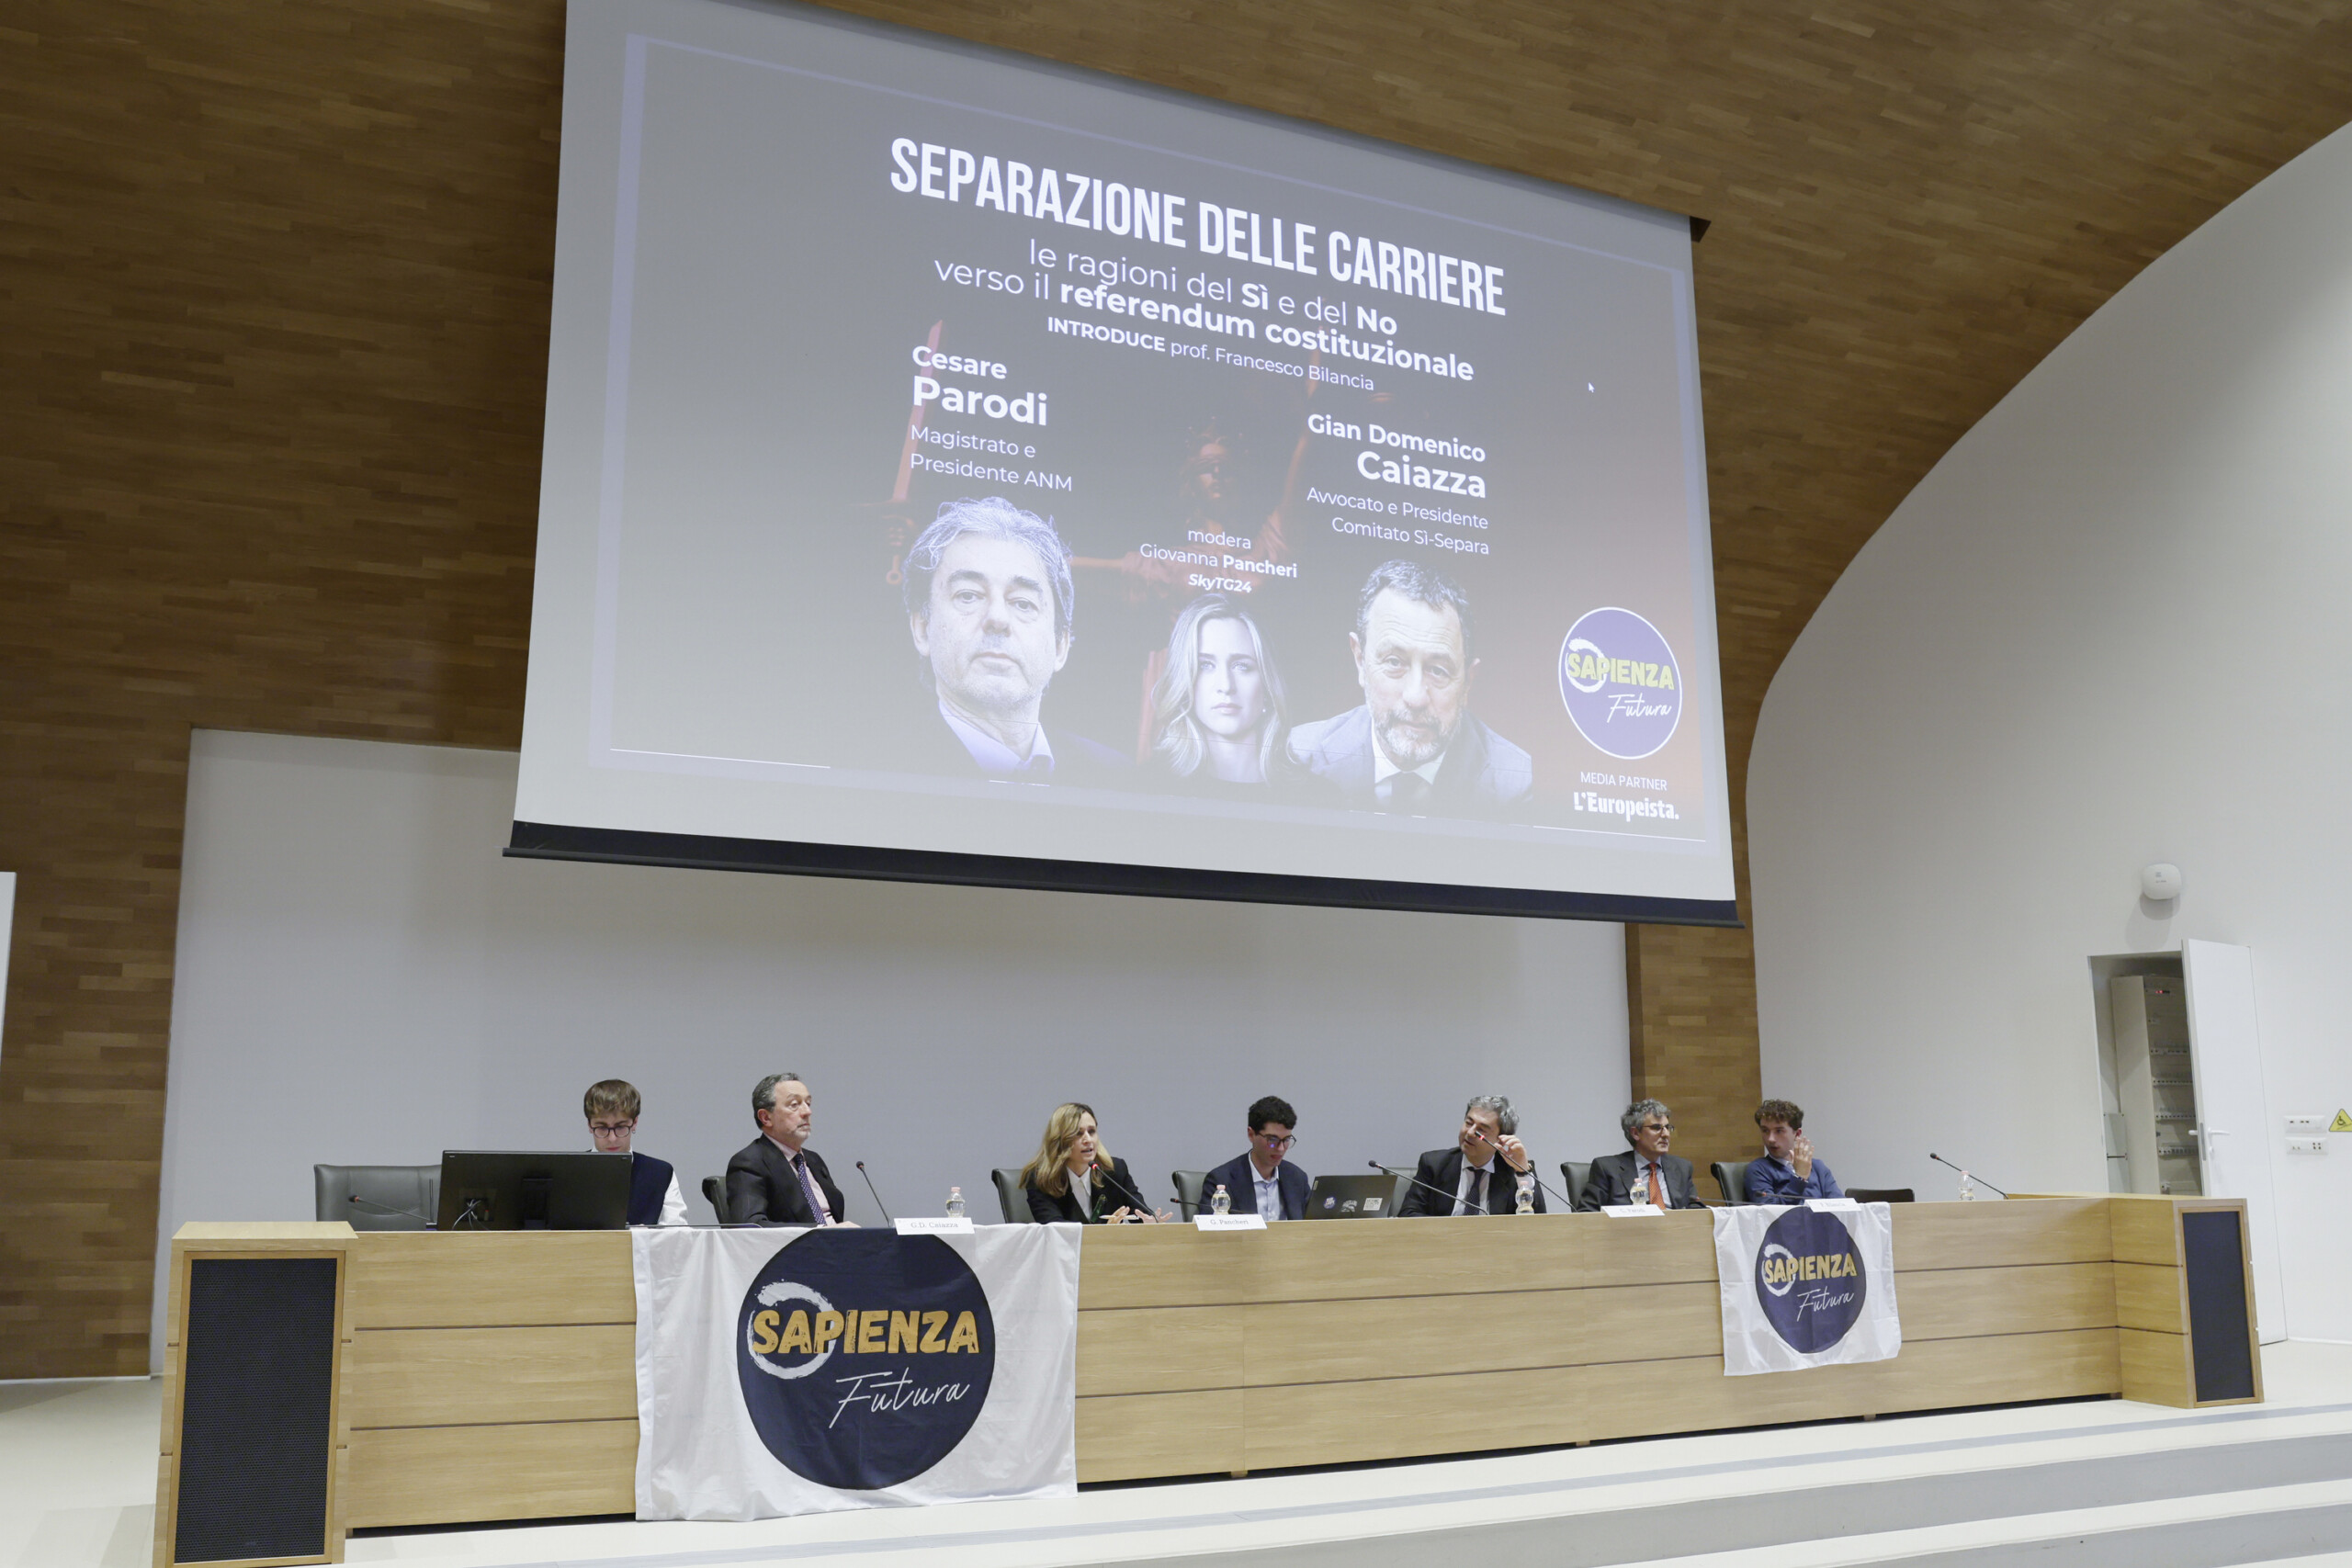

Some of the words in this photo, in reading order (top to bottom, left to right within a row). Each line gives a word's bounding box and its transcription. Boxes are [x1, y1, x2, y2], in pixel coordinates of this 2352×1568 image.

[890, 137, 1186, 249] SEPARAZIONE
[1199, 201, 1317, 276] DELLE
[1329, 231, 1506, 316] CARRIERE
[1030, 238, 1057, 268] le
[1068, 252, 1177, 292] ragioni
[1186, 272, 1232, 303] del
[1241, 282, 1269, 310] Sì
[1278, 296, 1295, 315] e
[1304, 296, 1347, 326] del
[1356, 305, 1397, 335] No
[934, 259, 1025, 295] verso
[1035, 271, 1049, 300] il
[1060, 282, 1256, 339] referendum
[1264, 323, 1475, 381] costituzionale
[912, 345, 1007, 379] Cesare
[1047, 316, 1166, 352] INTRODUCE
[1170, 342, 1210, 360] prof.
[1216, 348, 1304, 377] Francesco
[1308, 365, 1374, 390] Bilancia
[913, 375, 1048, 426] Parodi
[910, 423, 1019, 456] Magistrato
[1023, 445, 1036, 458] e
[1307, 413, 1362, 441] Gian
[1368, 423, 1486, 463] Domenico
[910, 453, 1020, 483] Presidente
[1023, 470, 1073, 492] ANM
[1357, 450, 1486, 499] Caiazza
[1306, 487, 1384, 513] Avvocato
[1387, 502, 1398, 515] e
[1402, 502, 1488, 529] Presidente
[1187, 529, 1251, 550] modera
[1331, 516, 1410, 543] Comitato
[1414, 529, 1489, 556] Sì-Separa
[1139, 543, 1218, 568] Giovanna
[1223, 554, 1297, 579] Pancheri
[1188, 573, 1252, 594] SkyTG24
[1567, 652, 1675, 691] SAPIENZA
[1606, 693, 1672, 724] Futura
[1580, 770, 1616, 787] MEDIA
[1619, 774, 1668, 792] PARTNER
[1763, 1252, 1858, 1285] SAPIENZA
[1796, 1285, 1856, 1323] Futura
[752, 1308, 980, 1355] SAPIENZA
[828, 1366, 970, 1429] Futura
